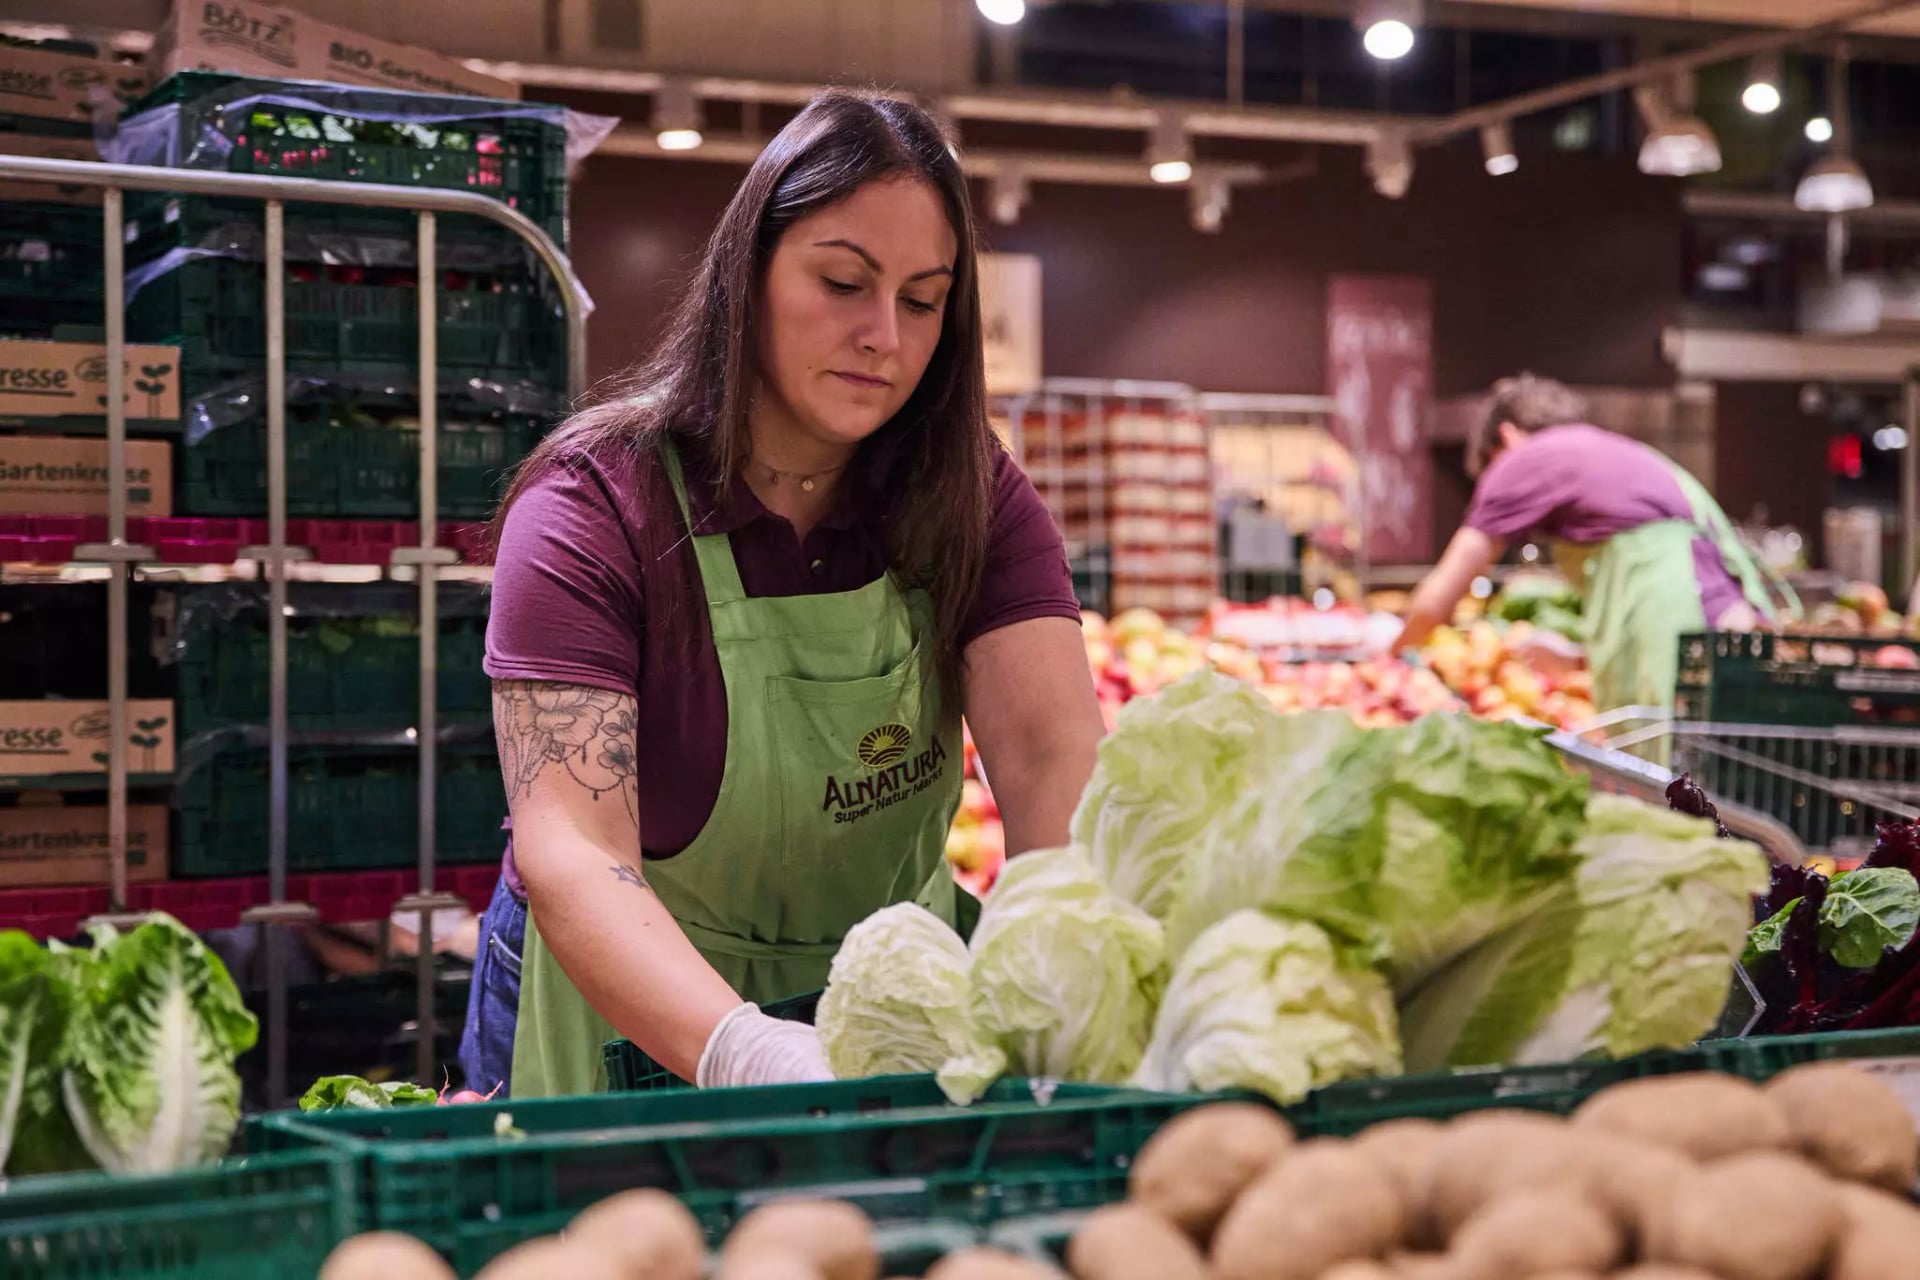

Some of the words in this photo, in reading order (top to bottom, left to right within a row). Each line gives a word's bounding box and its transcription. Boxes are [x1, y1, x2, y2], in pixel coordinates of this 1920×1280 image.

[822, 734, 946, 811] ALNATURA
[834, 803, 874, 824] Super
[875, 789, 911, 811] Natur
[912, 766, 943, 795] Markt
